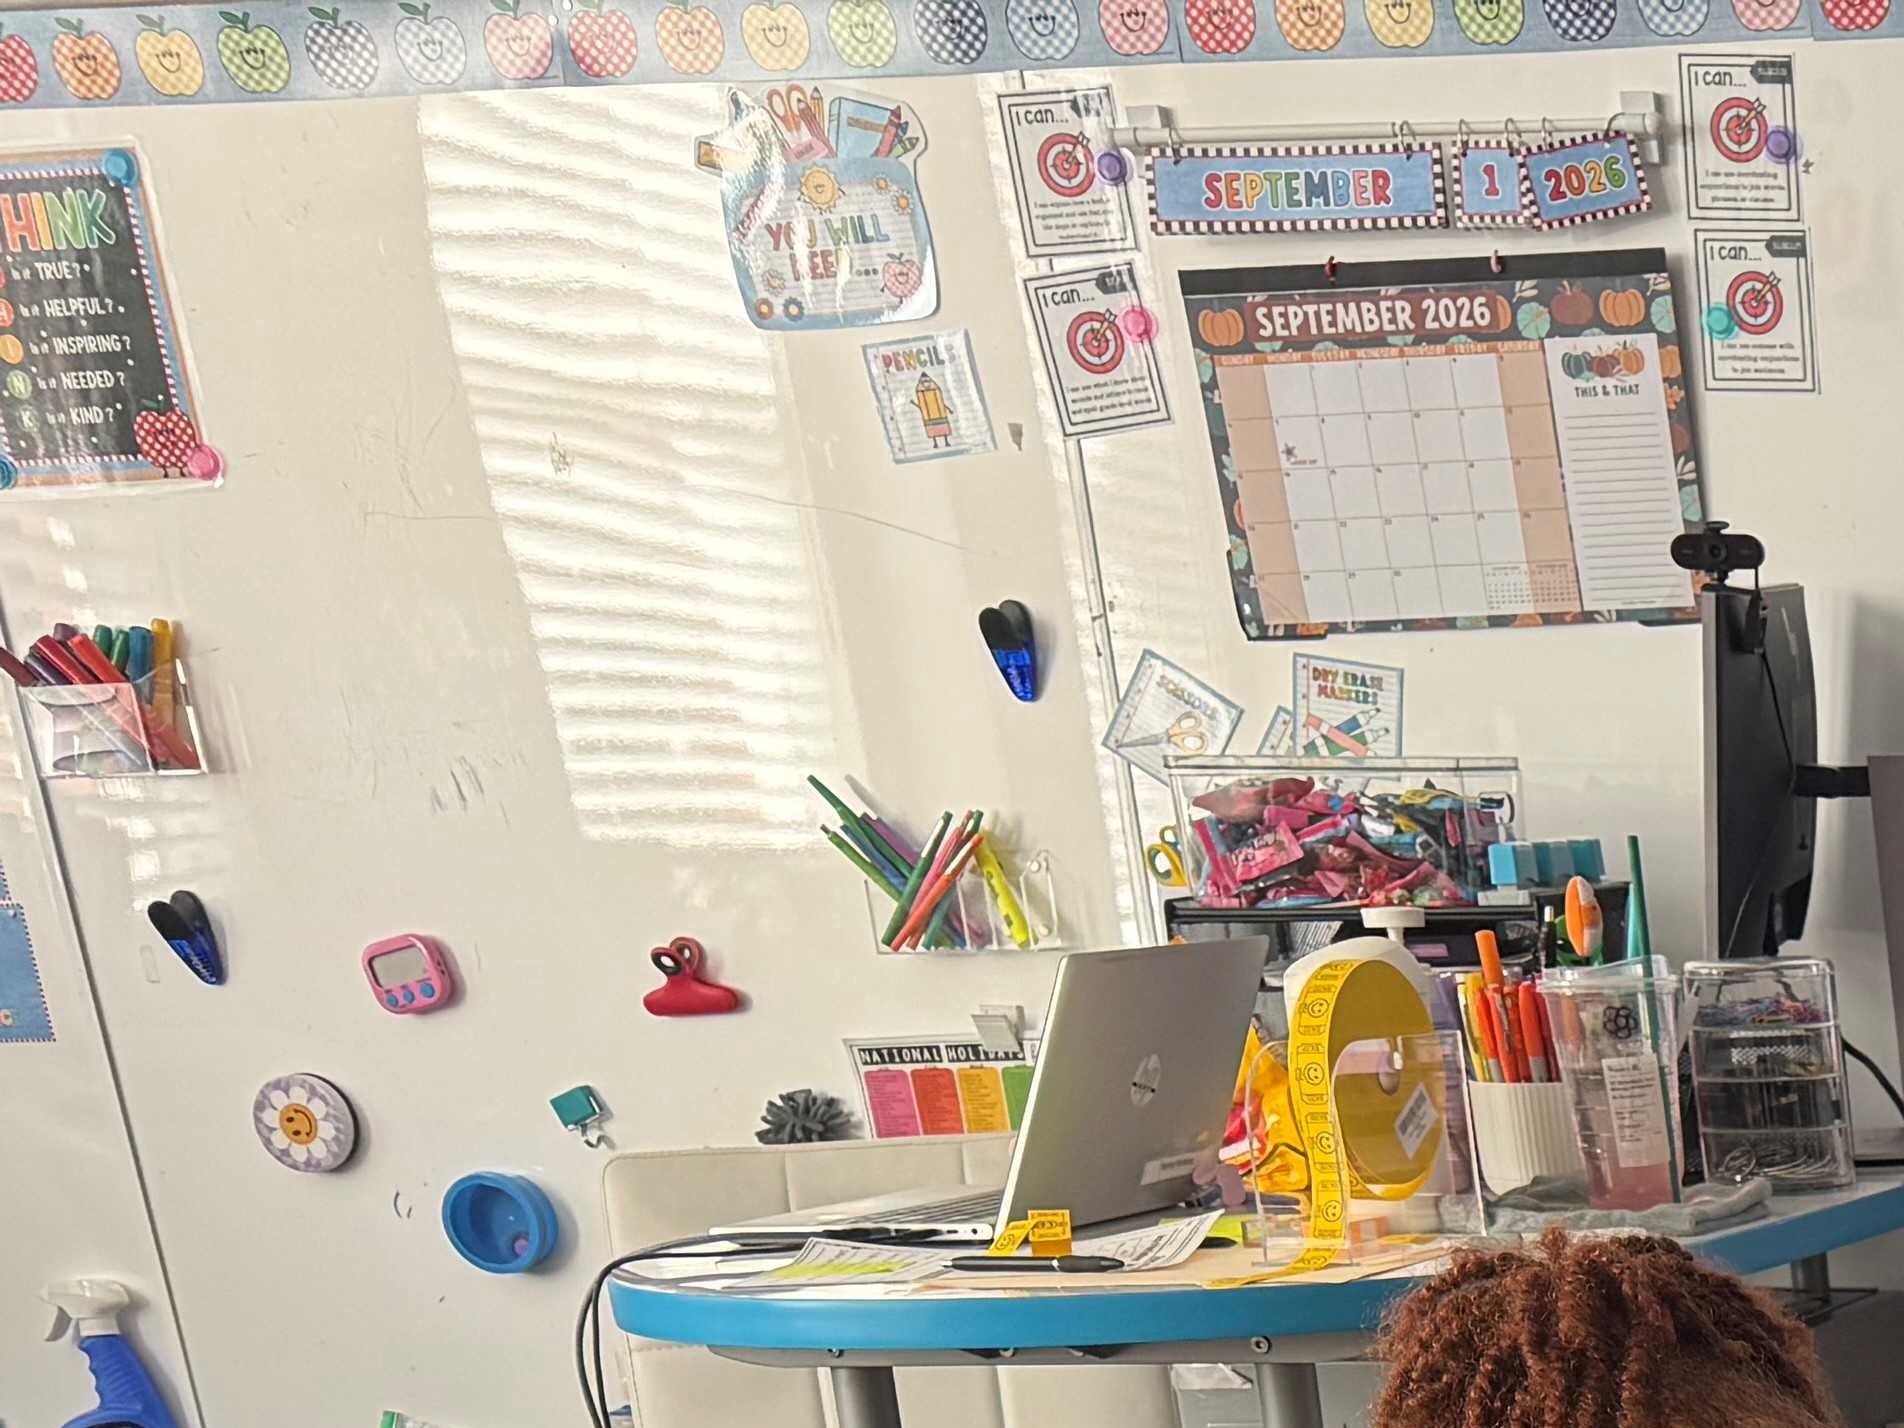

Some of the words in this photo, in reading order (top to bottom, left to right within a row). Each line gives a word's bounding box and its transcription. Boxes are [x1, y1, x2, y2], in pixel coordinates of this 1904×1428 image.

[1694, 71, 1699, 86] I
[1015, 110, 1022, 126] I
[1203, 168, 1393, 210] SEPTEMBER
[1482, 163, 1500, 198] 1
[1543, 156, 1626, 202] 2026
[0, 188, 116, 252] HINK
[826, 213, 890, 248] WILL
[1709, 245, 1715, 261] I
[44, 298, 113, 319] HELPFUL?
[1042, 293, 1049, 308] I
[1255, 300, 1412, 339] SEPTEMBER
[1425, 297, 1492, 331] 2026
[53, 335, 132, 356] INSPIRING?
[1575, 386, 1599, 398] THIS
[1602, 385, 1612, 398] &
[1614, 383, 1640, 398] THAT
[1311, 666, 1339, 684] DRY
[1343, 671, 1384, 692] ERASE
[859, 1046, 941, 1064] NATIONAL
